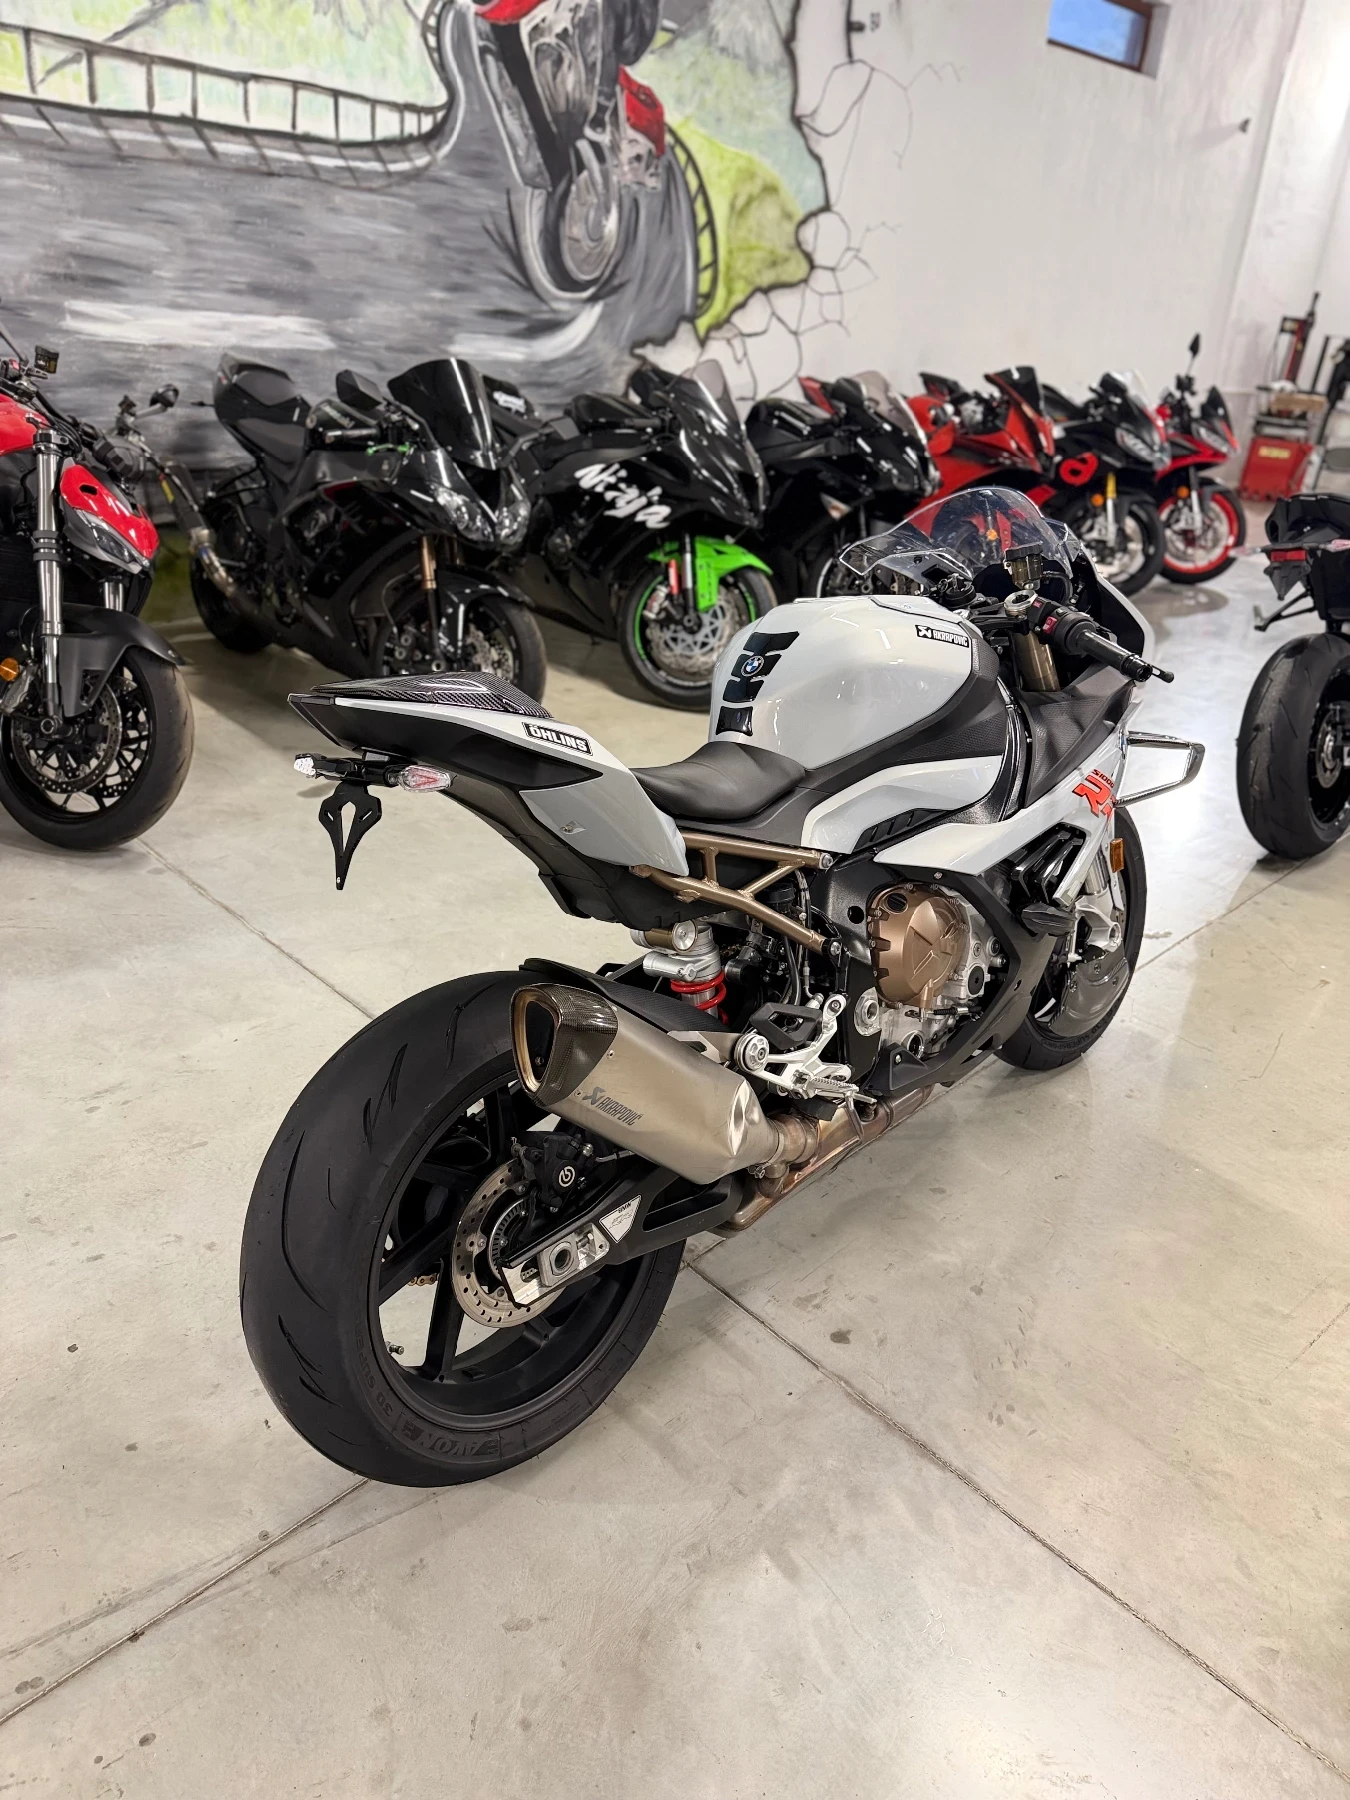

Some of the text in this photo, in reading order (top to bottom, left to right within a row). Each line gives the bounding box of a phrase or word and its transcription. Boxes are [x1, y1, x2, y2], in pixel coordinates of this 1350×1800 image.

[574, 463, 672, 529] Ninja
[528, 724, 588, 752] ÖHLINS
[414, 1430, 487, 1456] AVON
